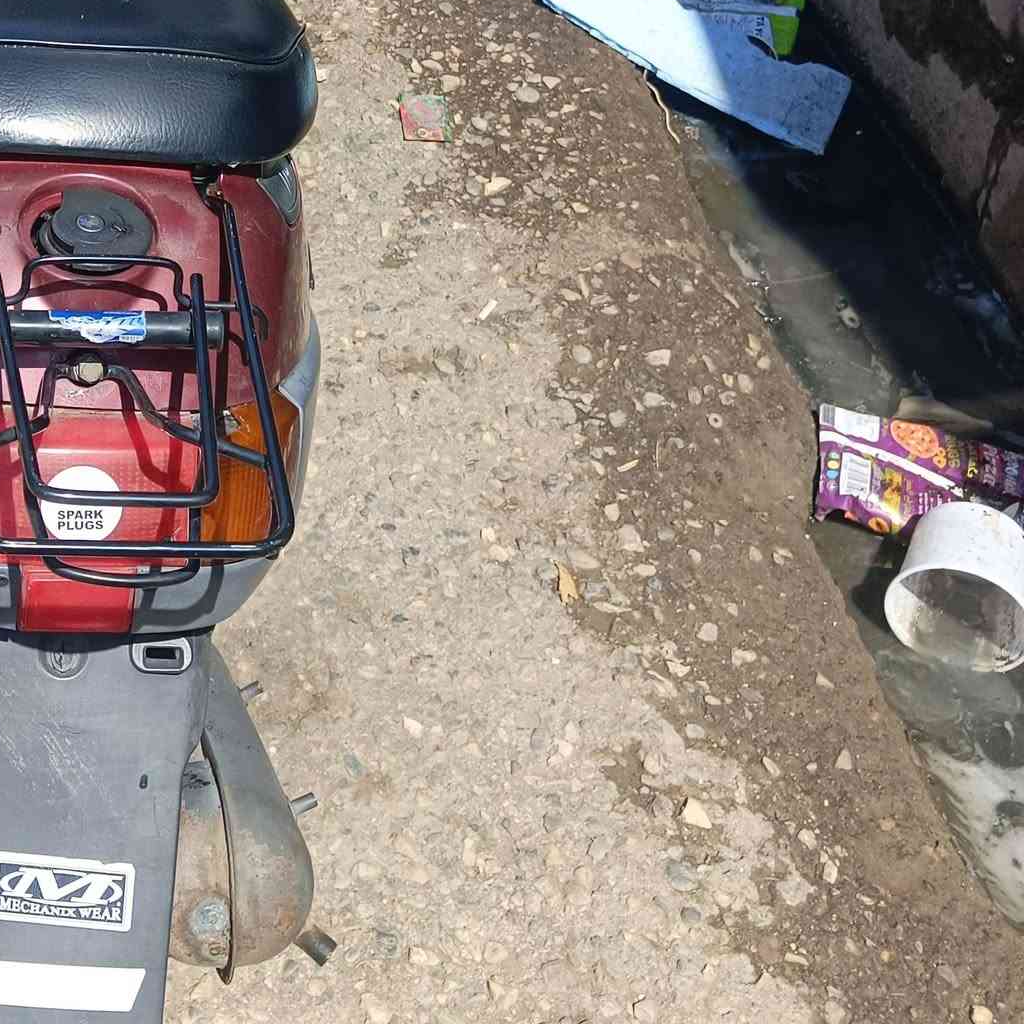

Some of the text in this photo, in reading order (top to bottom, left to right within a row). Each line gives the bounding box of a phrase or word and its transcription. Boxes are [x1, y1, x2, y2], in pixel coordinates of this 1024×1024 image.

[57, 509, 104, 520] SPARK
[57, 520, 104, 531] PLUGS
[76, 906, 122, 921] WEAR
